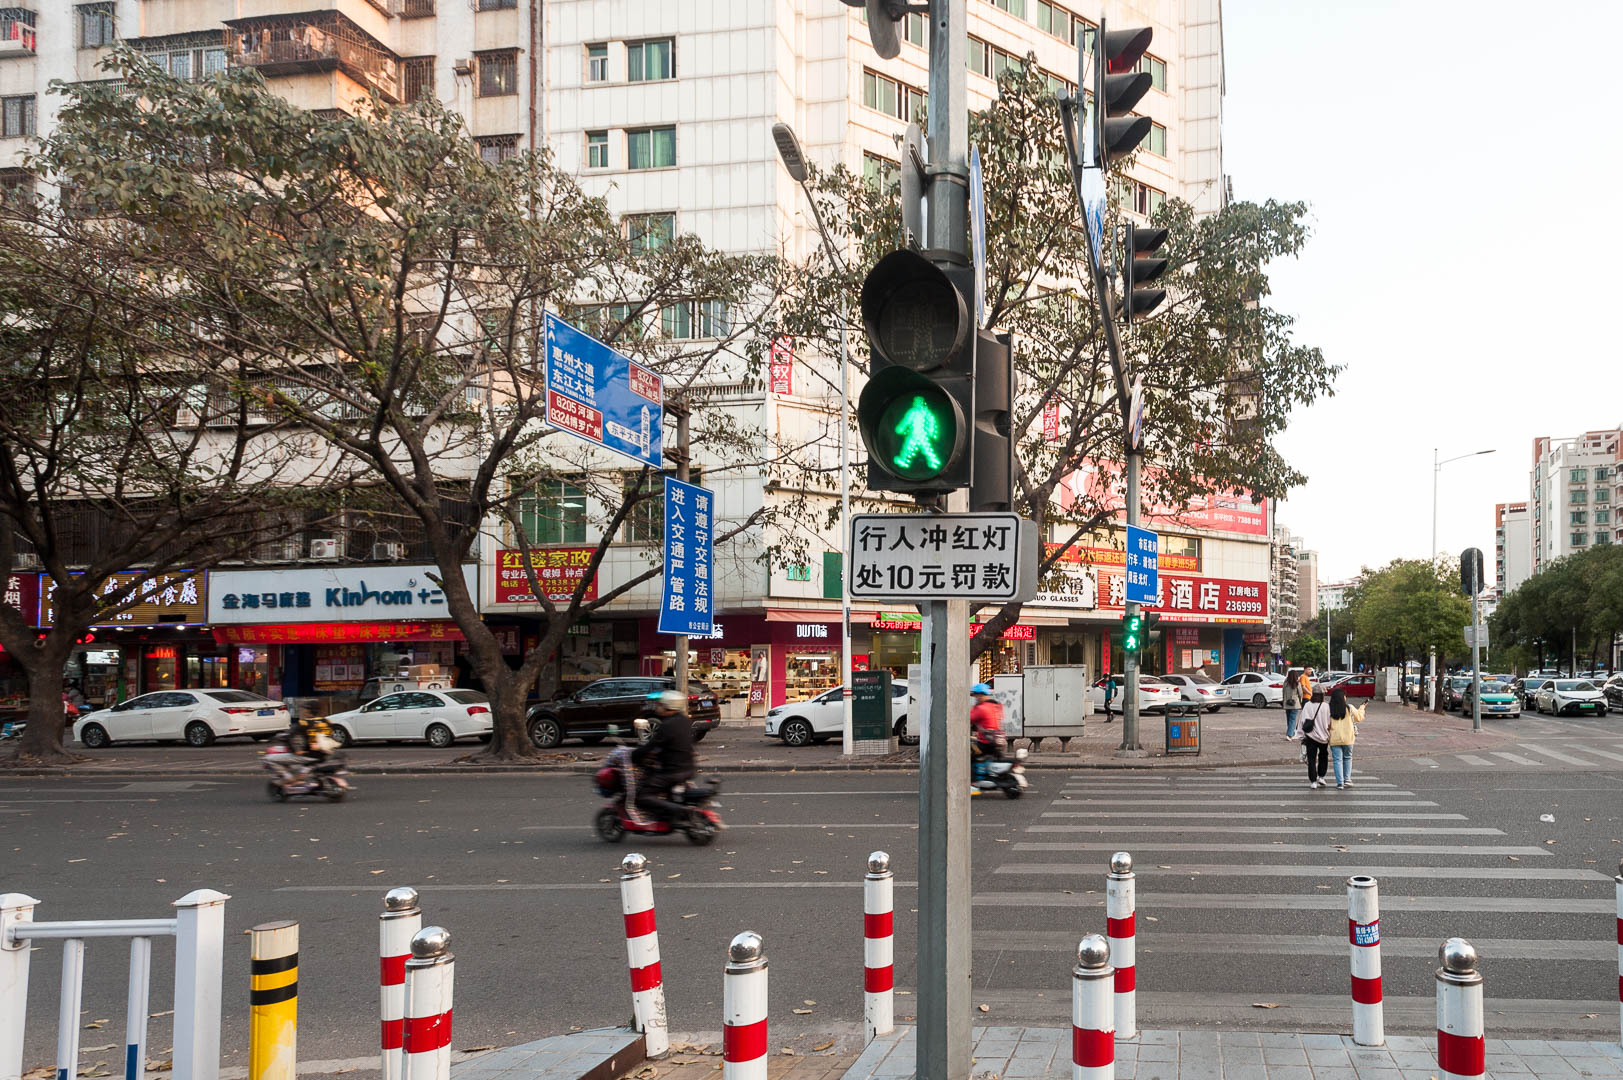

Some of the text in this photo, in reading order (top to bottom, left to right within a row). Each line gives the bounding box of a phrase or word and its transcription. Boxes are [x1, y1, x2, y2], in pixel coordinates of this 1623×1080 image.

[552, 345, 595, 378] 惠州大道
[552, 368, 595, 398] 东江大桥
[669, 486, 685, 611] 进入交通严管路
[859, 524, 1011, 552] 行人冲红灯
[694, 494, 708, 614] 请遵守交通法规
[542, 568, 561, 578] 保姆
[856, 562, 1011, 590] 处10元罚款
[325, 580, 413, 607] Kinhom
[1050, 595, 1079, 603] GLASSES
[1225, 600, 1262, 612] 2369999
[1131, 618, 1138, 631] 2
